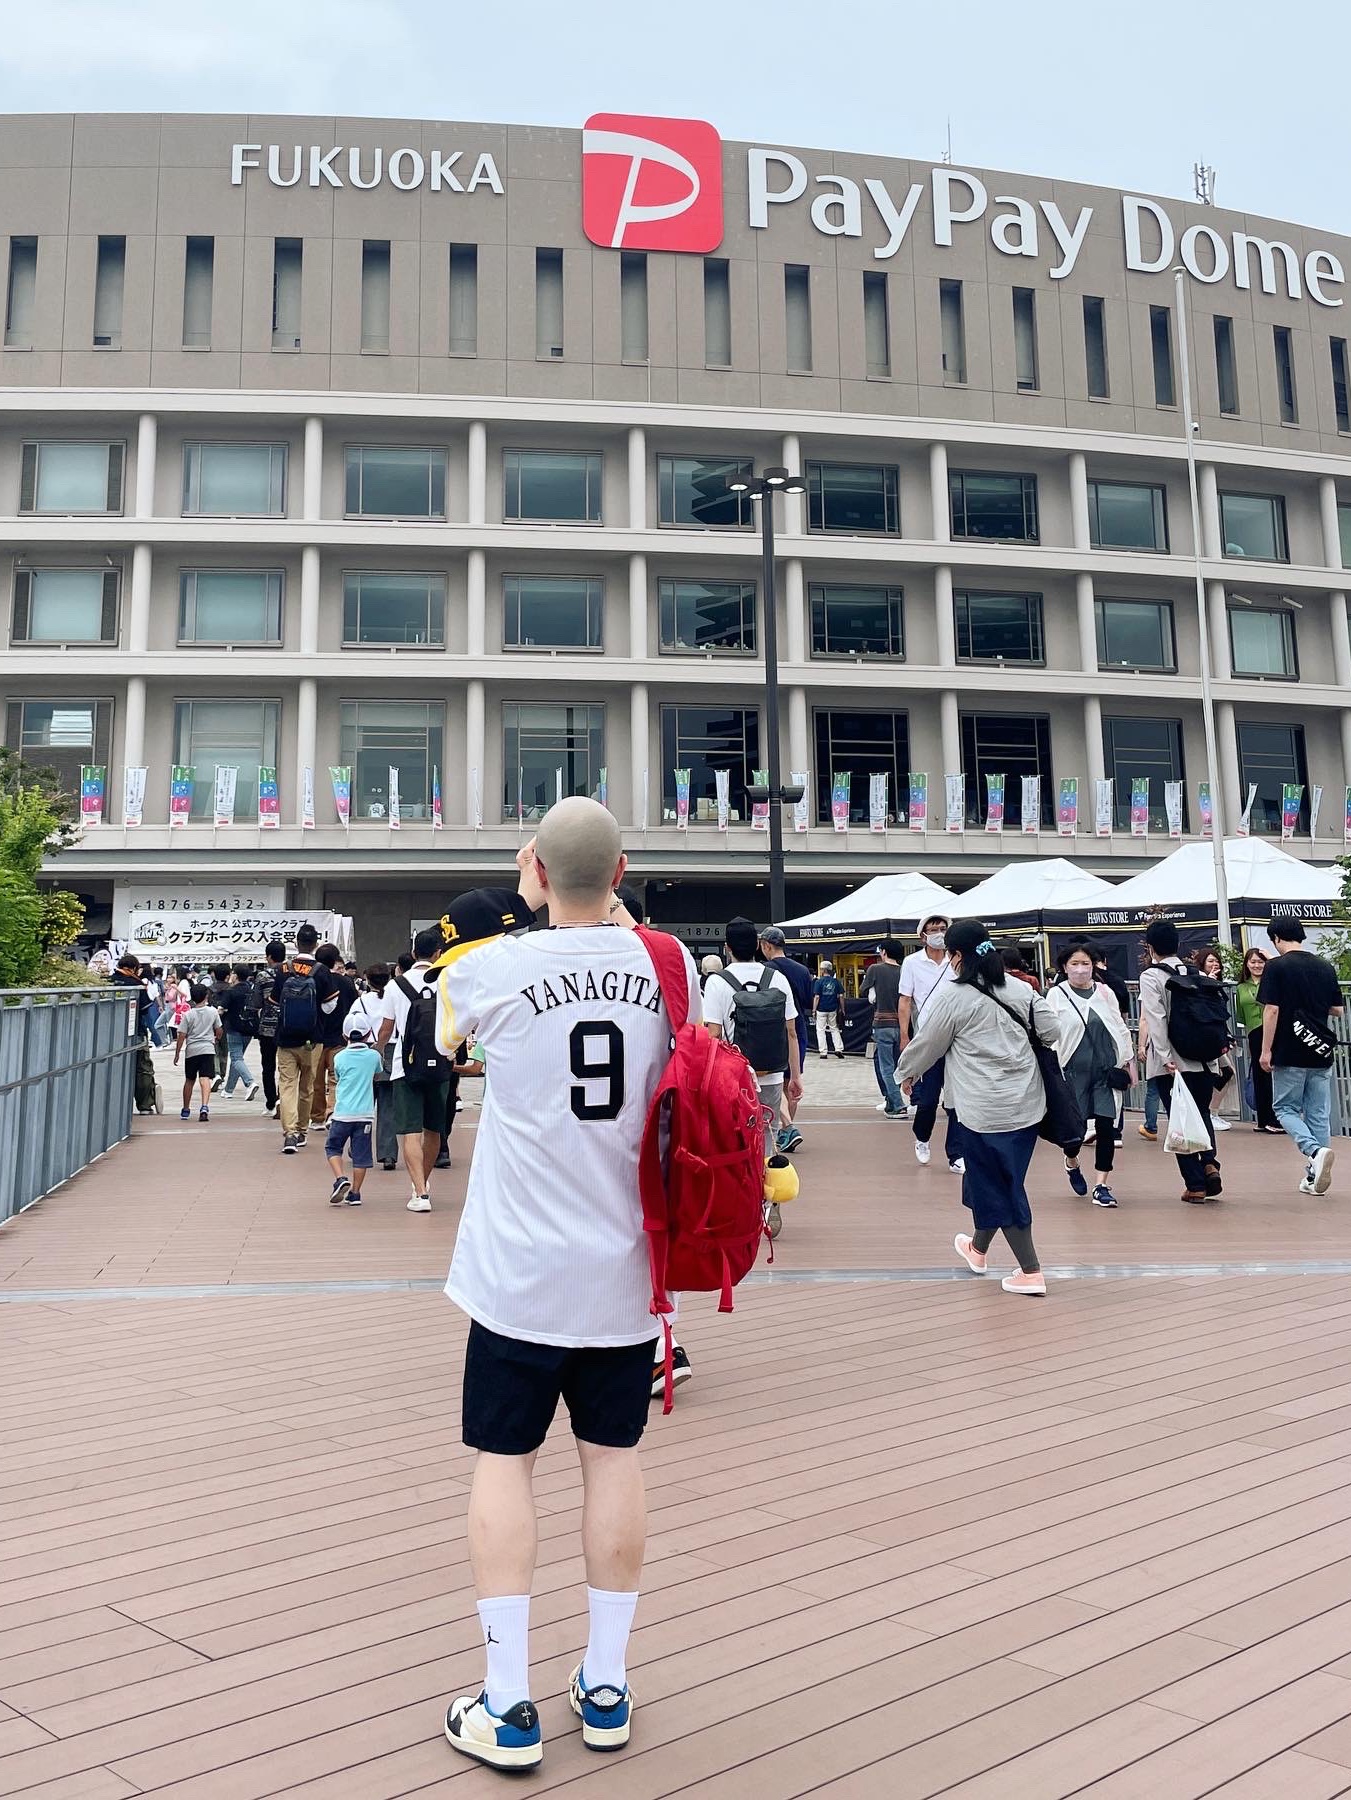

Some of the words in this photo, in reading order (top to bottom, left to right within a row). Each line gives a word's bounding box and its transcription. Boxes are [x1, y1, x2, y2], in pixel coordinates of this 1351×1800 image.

[231, 143, 505, 195] FUKUOKA
[747, 147, 1094, 280] PayPay
[1122, 195, 1346, 308] Dome
[190, 919, 228, 929] ホークス
[232, 918, 309, 929] 公式ファンクラブ
[1087, 912, 1109, 924] HAWKS
[1109, 911, 1129, 924] STORE
[1270, 903, 1302, 917] HAWKS
[1303, 904, 1333, 918] STORE
[168, 930, 328, 944] クラブホークス入会受中!
[520, 969, 662, 1016] YANAGITA
[569, 1019, 625, 1121] 9
